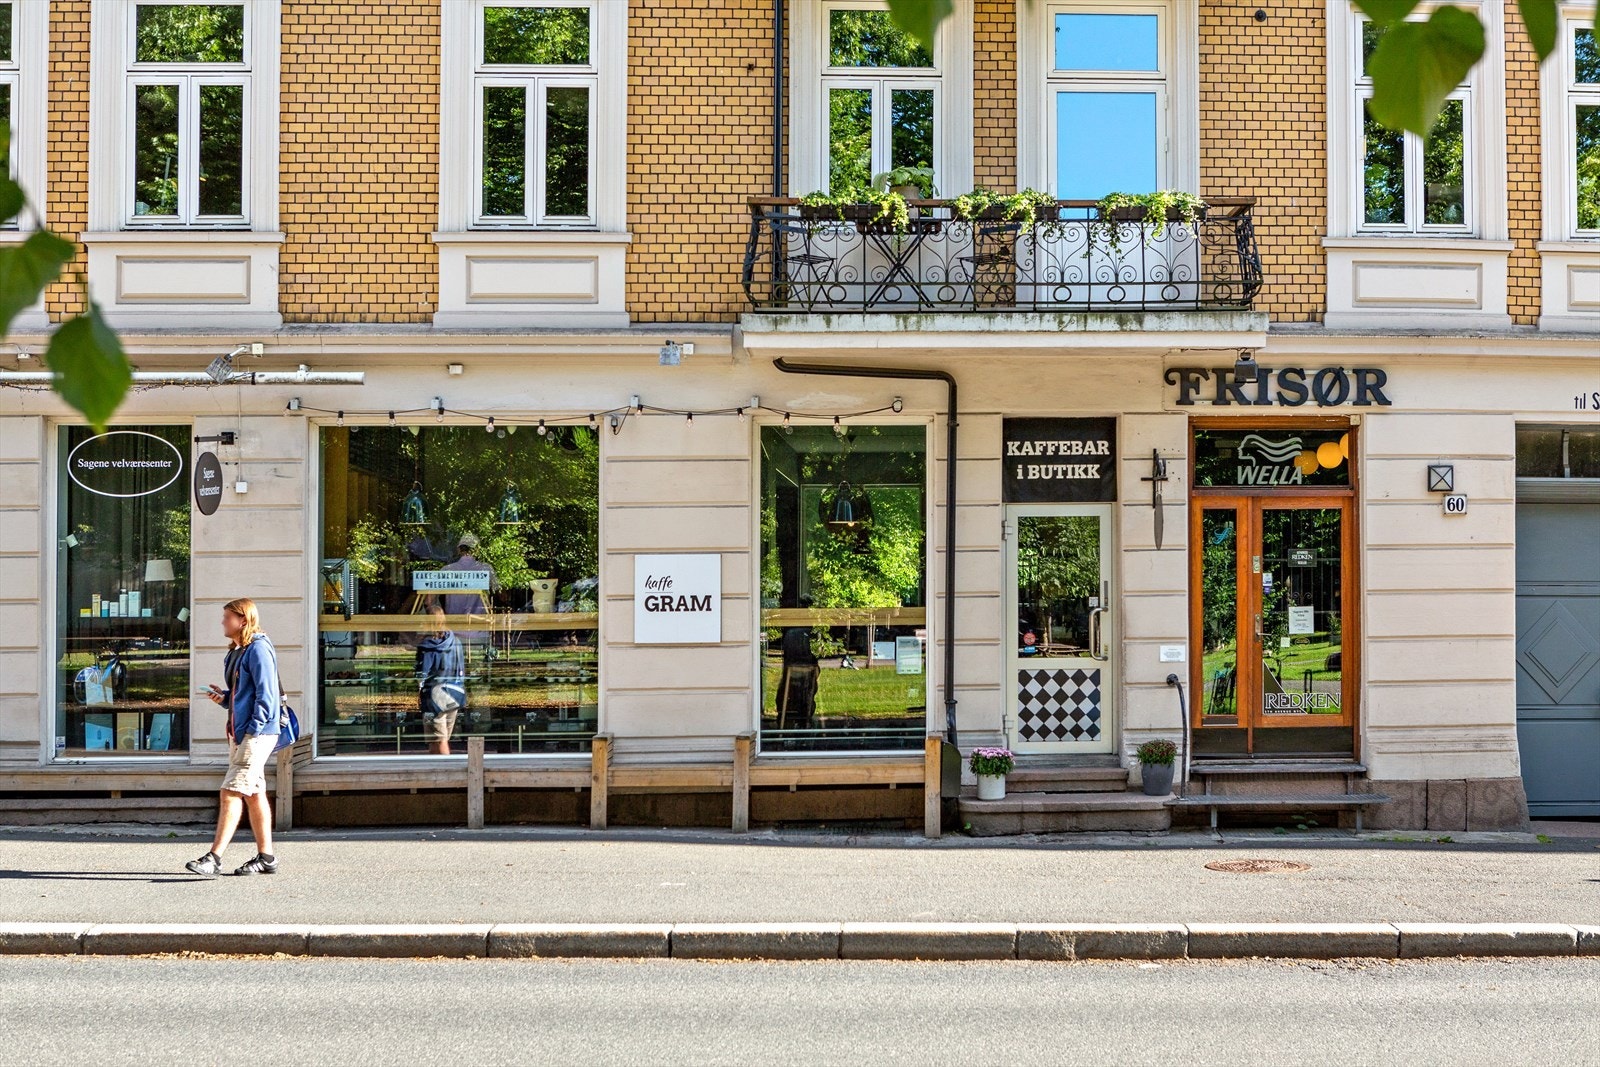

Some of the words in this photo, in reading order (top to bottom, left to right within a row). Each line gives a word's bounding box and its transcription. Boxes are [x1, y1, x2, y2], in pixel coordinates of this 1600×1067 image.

[1164, 366, 1392, 408] FRISØR
[1574, 392, 1586, 409] til
[1006, 440, 1110, 456] KAFFEBAR
[77, 458, 109, 470] Sagene
[111, 458, 173, 468] velværesenter
[1016, 464, 1024, 480] i
[1027, 464, 1101, 479] BUTIKK
[1237, 465, 1303, 485] WELLA
[1447, 497, 1465, 512] 60
[644, 575, 673, 591] kaffe
[644, 595, 712, 612] GRAM
[1264, 692, 1341, 708] REDKEN
